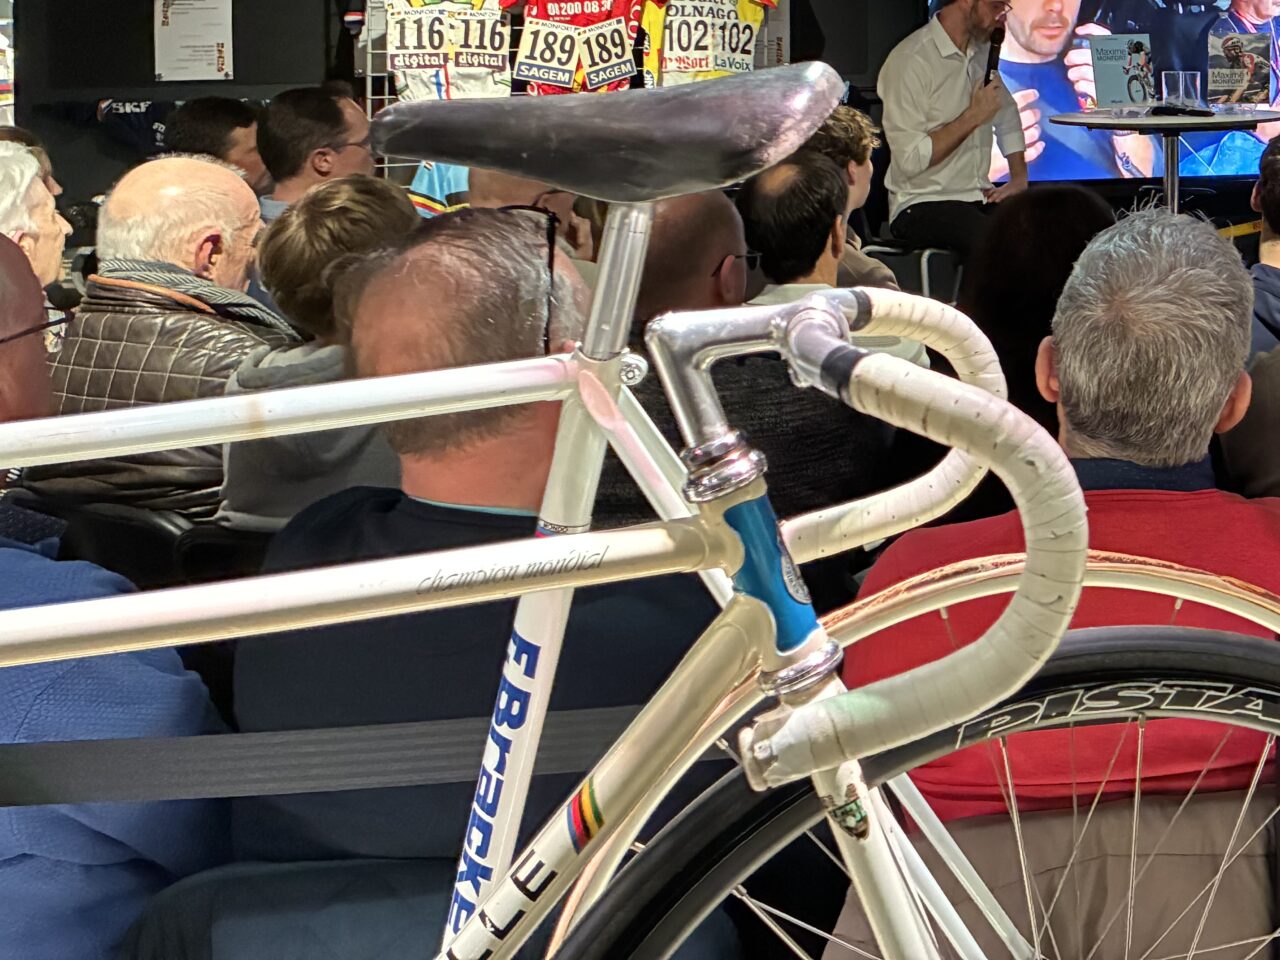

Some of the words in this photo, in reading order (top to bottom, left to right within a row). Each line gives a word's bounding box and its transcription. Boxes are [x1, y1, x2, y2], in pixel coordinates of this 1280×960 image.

[665, 4, 739, 21] OLNAGO
[395, 16, 445, 51] 116
[460, 19, 506, 51] 116
[524, 28, 576, 67] 189
[582, 27, 626, 68] 189
[665, 19, 709, 52] 102
[719, 21, 754, 55] 102
[1096, 47, 1127, 56] Maxime
[519, 64, 570, 83] SAGEM
[589, 62, 633, 84] SAGEM
[1211, 70, 1244, 79] Maxime
[111, 101, 152, 114] SKF
[416, 563, 521, 595] champion
[522, 545, 610, 579] mondial
